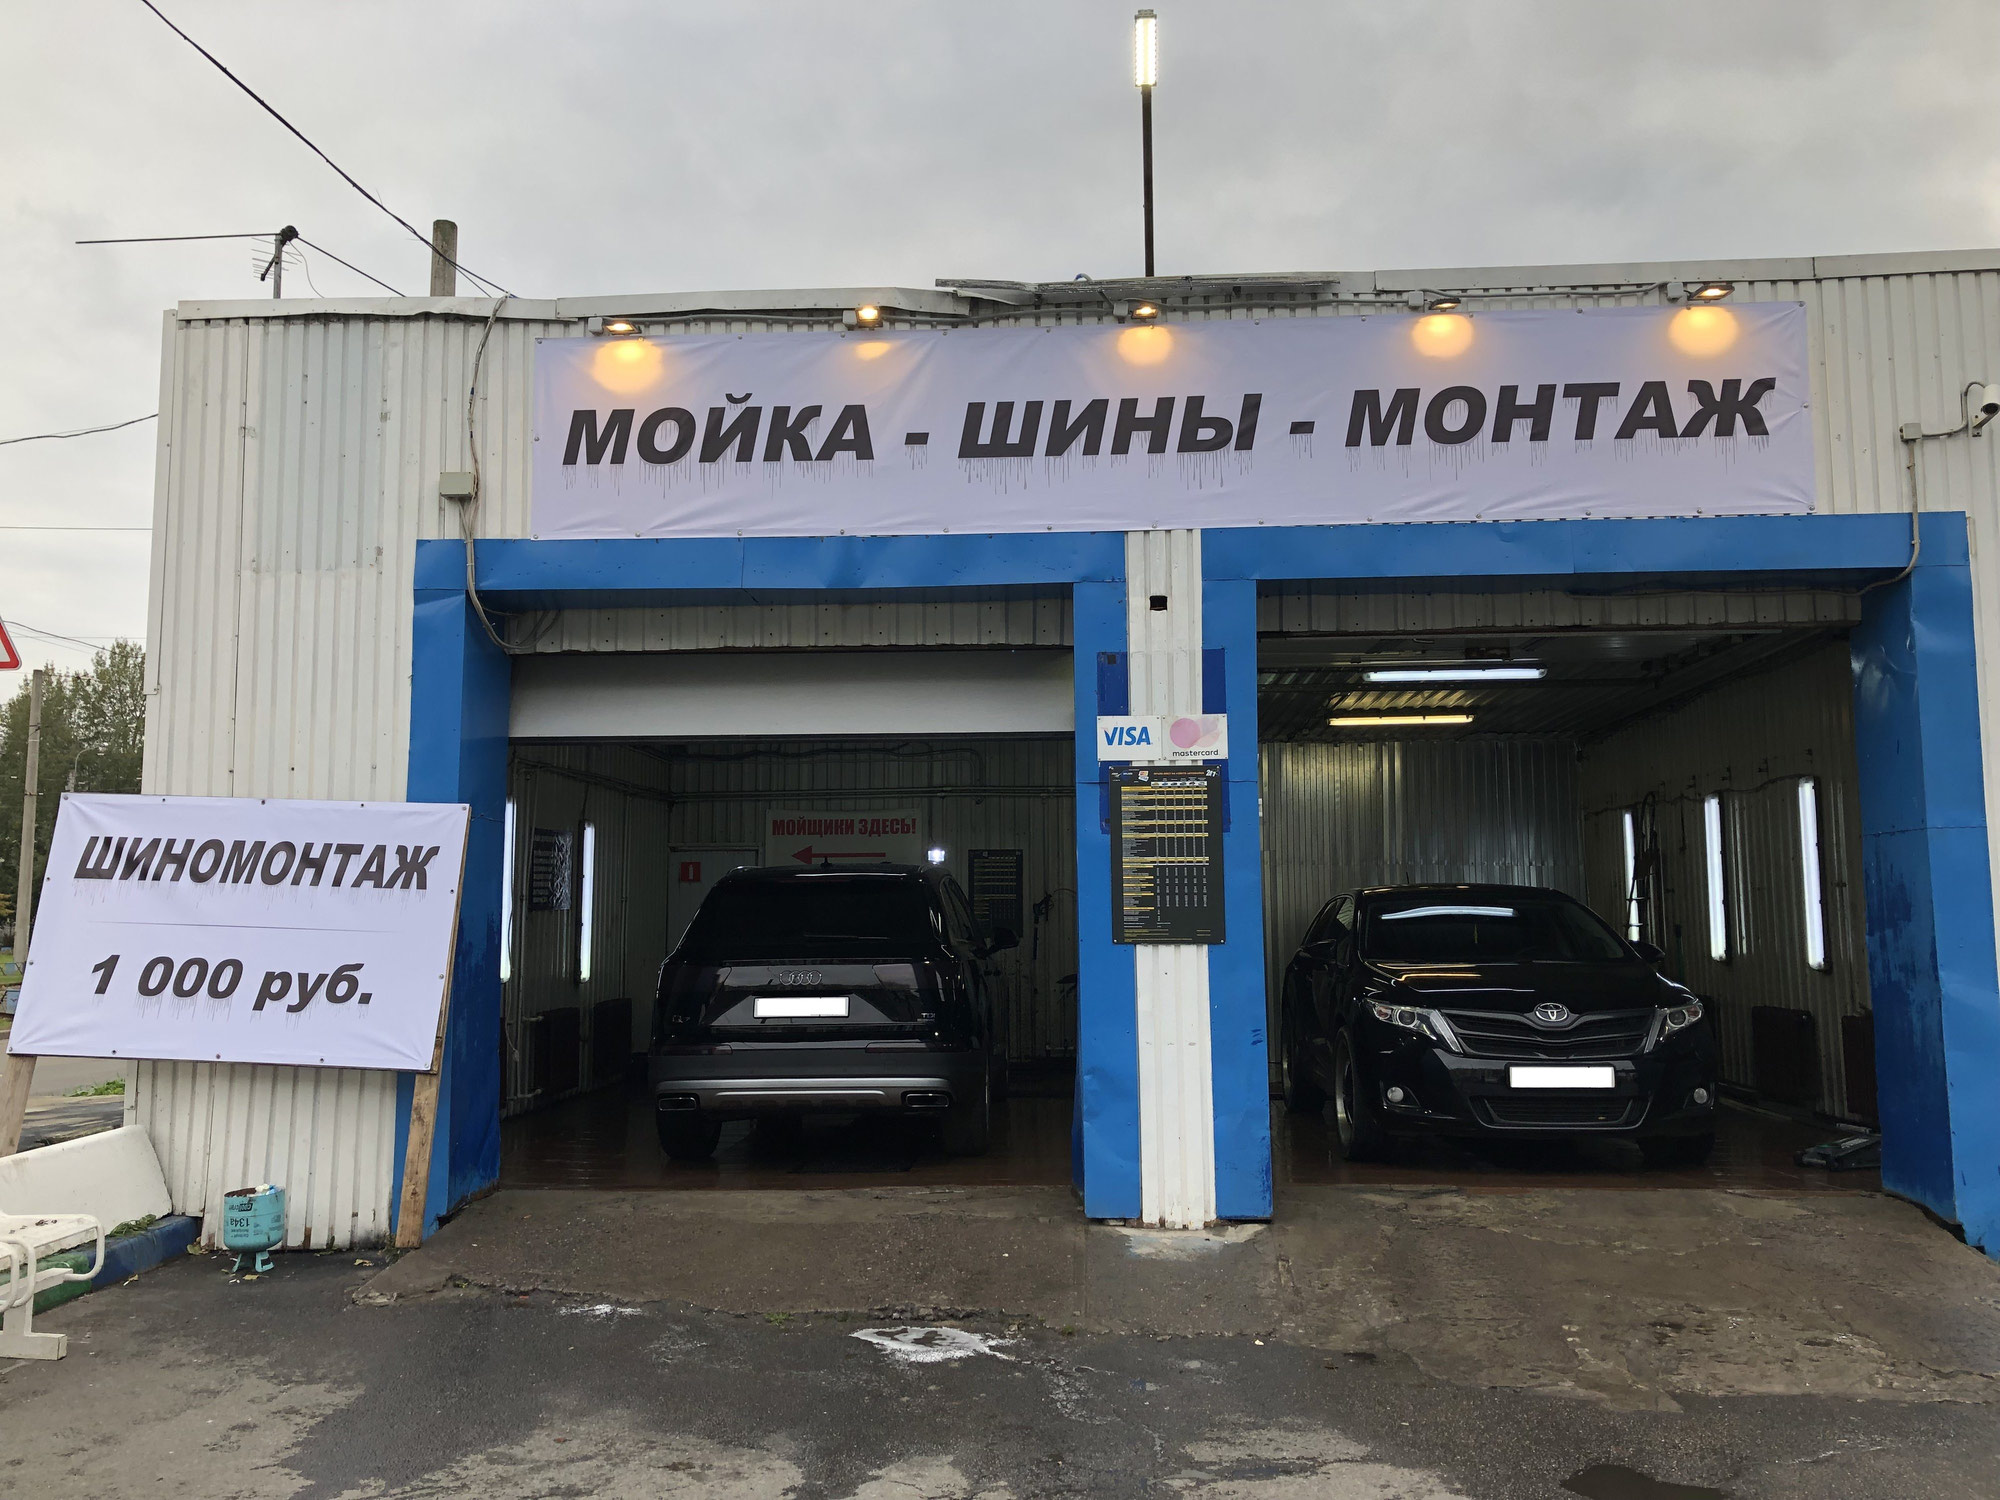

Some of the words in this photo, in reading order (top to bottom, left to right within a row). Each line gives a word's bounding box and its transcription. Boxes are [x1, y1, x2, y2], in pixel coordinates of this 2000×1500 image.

[562, 392, 875, 466] МОЙКА
[904, 432, 930, 446] -
[957, 393, 1263, 460] ШИНЫ
[1289, 420, 1316, 435] -
[1344, 377, 1777, 448] МОНТАЖ
[1102, 726, 1151, 746] VISA
[1172, 749, 1219, 757] mastercard
[772, 816, 855, 837] МОЙЩИКИ
[858, 818, 917, 837] ЗДЕСЬ!
[73, 836, 441, 891] ШИНОМОНТАЖ
[91, 954, 121, 995] 1
[138, 956, 244, 999] 000
[252, 963, 373, 1013] руб.
[229, 1217, 250, 1227] 134a
